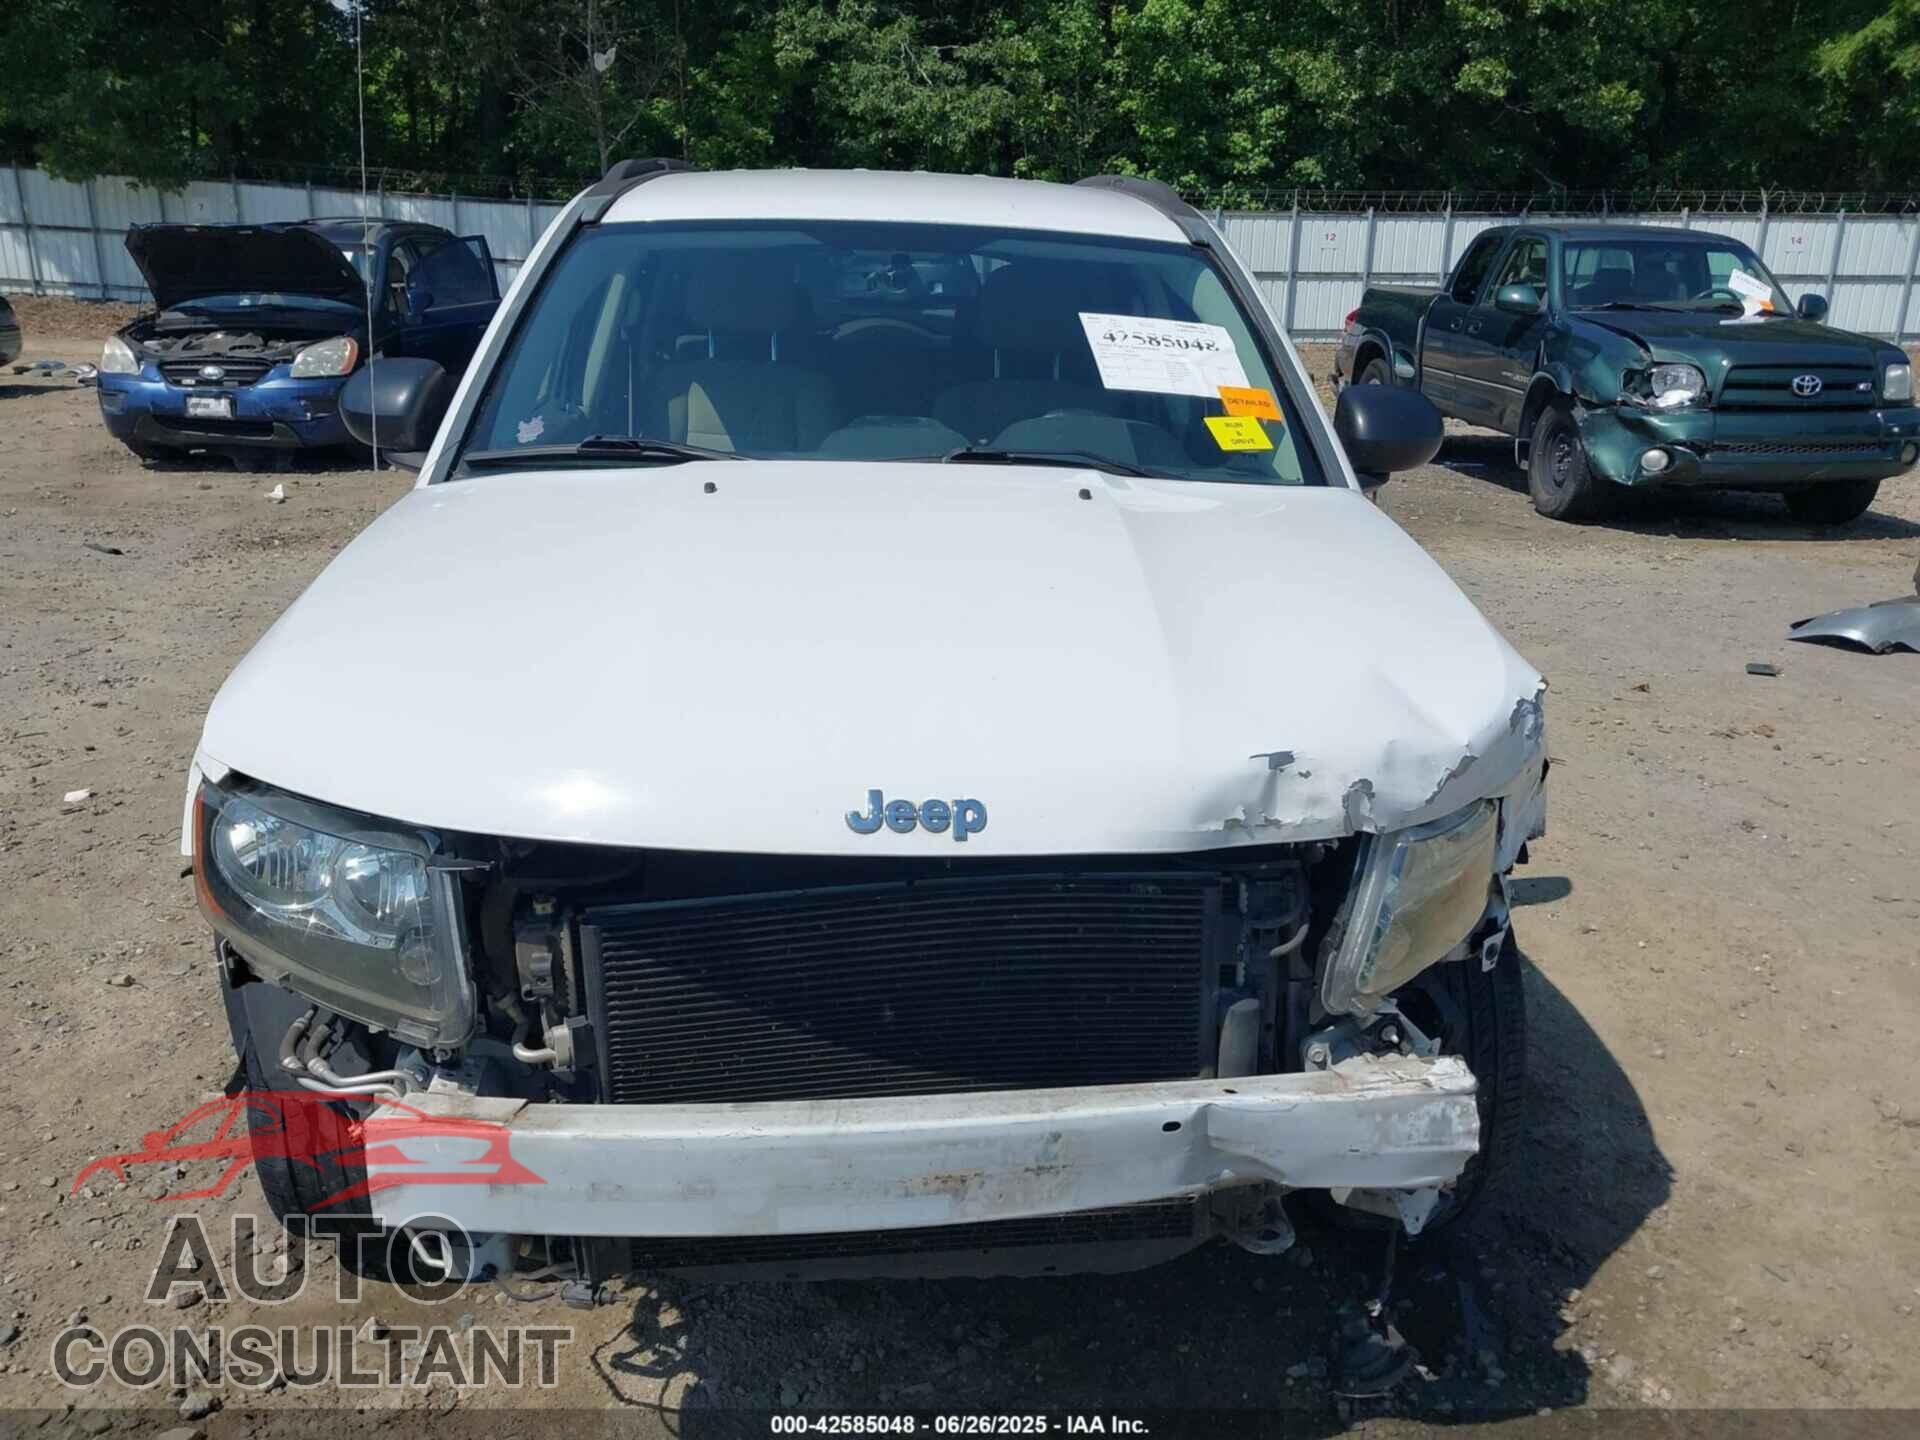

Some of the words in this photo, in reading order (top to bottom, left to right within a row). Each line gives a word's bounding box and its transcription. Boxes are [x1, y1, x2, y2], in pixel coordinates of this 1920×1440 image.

[1325, 232, 1337, 241] 12
[1791, 236, 1802, 245] 14
[845, 789, 988, 842] Jeep
